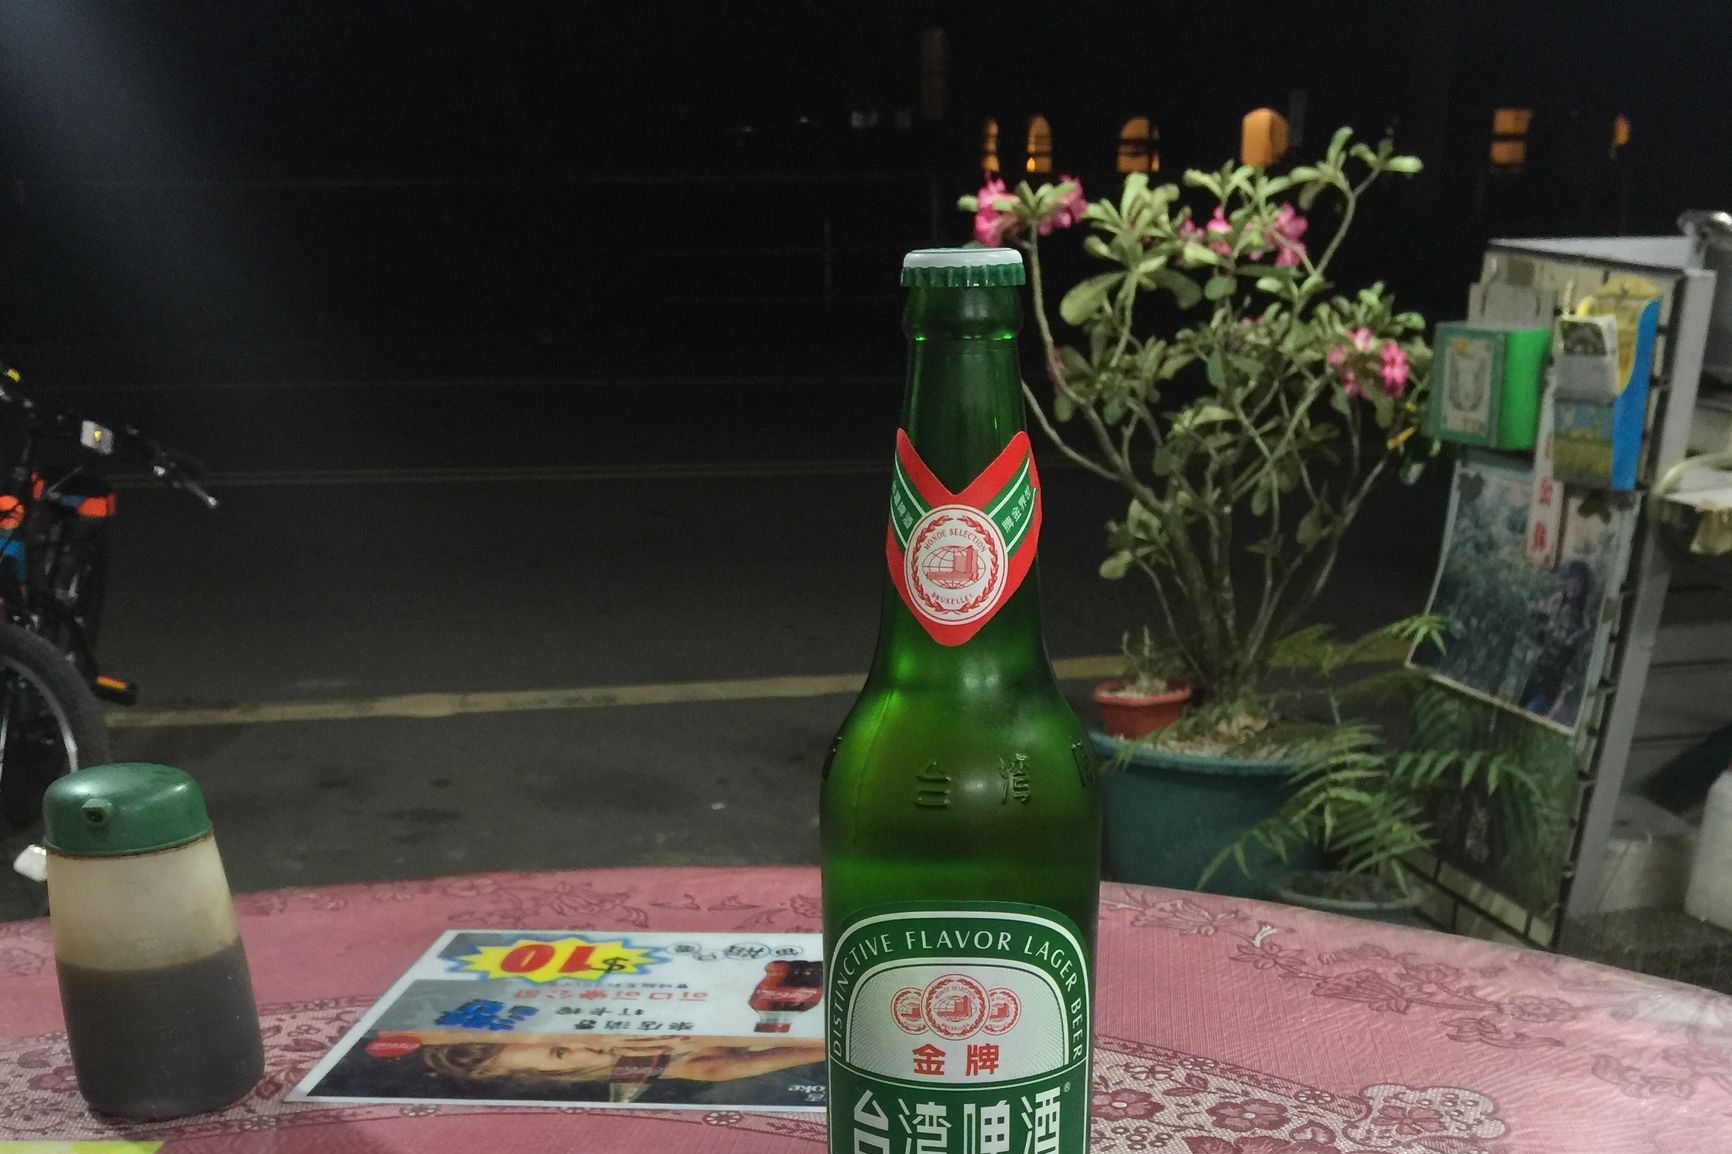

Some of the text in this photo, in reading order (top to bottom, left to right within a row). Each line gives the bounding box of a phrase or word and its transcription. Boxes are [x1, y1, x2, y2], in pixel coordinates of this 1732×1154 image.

[924, 528, 987, 553] MONDE SELECTION
[931, 591, 974, 605] BRUXELLES
[833, 930, 1084, 1061] DISTINCTIVE FLAVOR LAGER BEER
[912, 1043, 1000, 1076] 金牌
